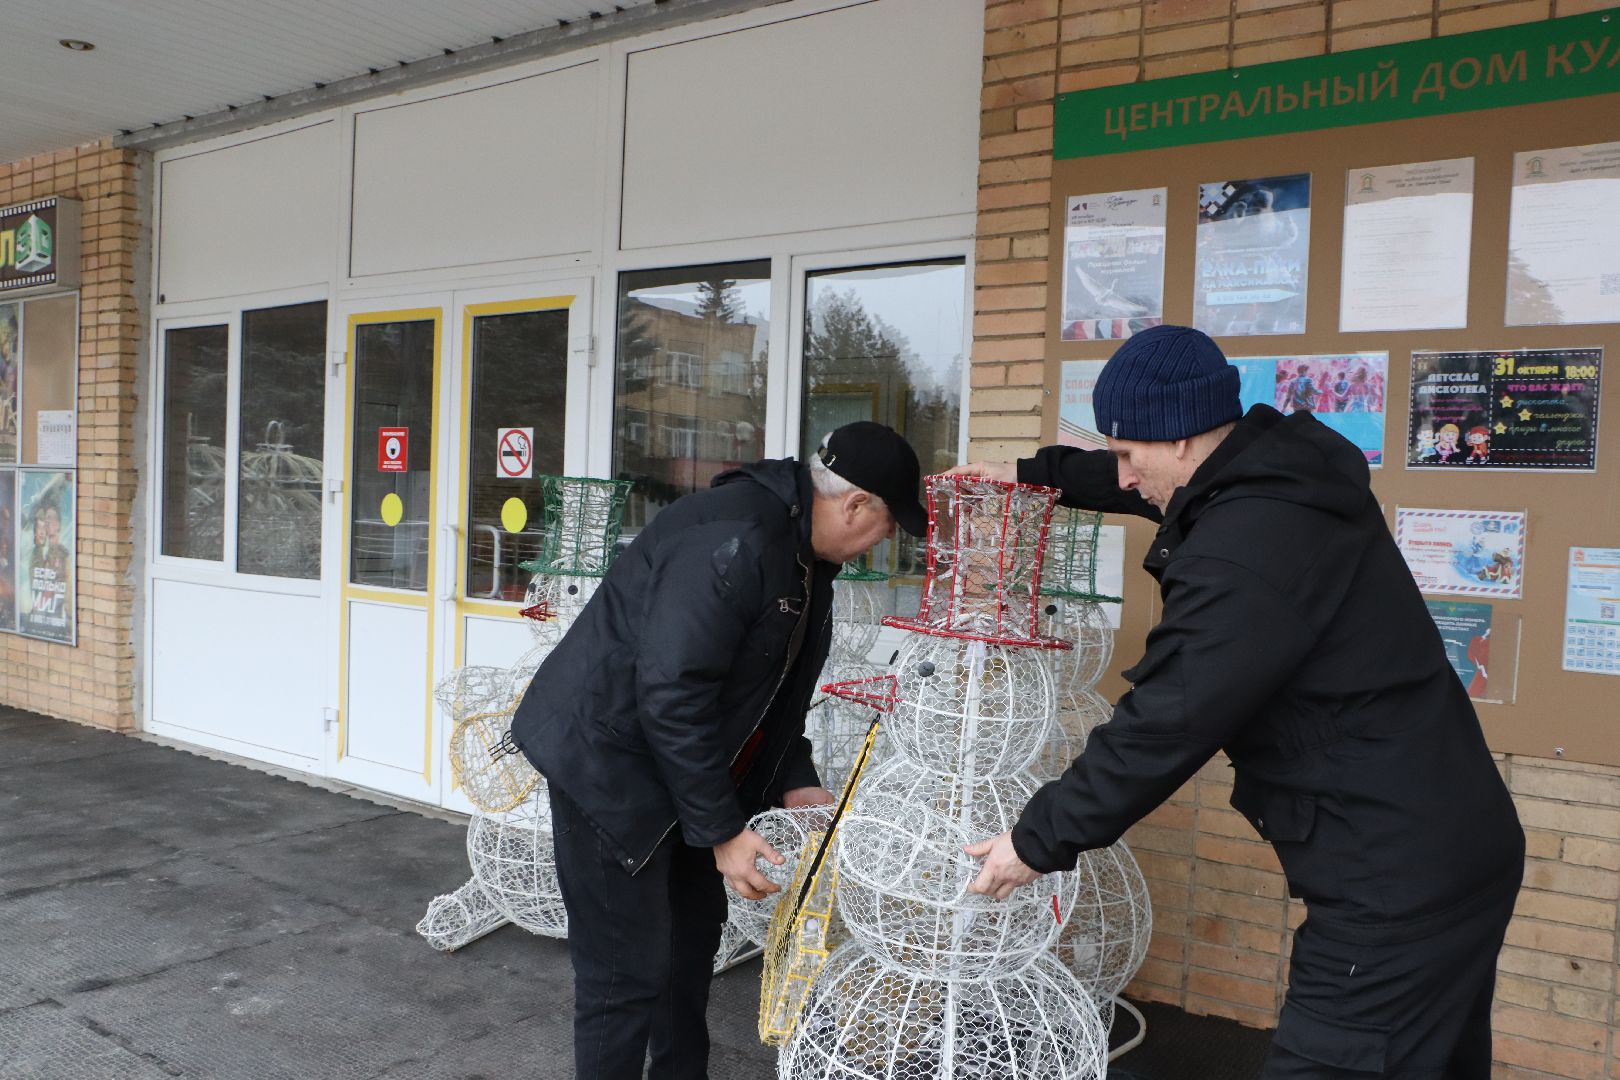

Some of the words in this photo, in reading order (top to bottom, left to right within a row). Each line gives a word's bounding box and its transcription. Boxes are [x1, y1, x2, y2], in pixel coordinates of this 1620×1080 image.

[1104, 59, 1398, 140] ЦЕНТРАЛЬНЫЙ
[1412, 50, 1528, 104] ДОМ
[1494, 357, 1515, 376] 31
[1517, 365, 1559, 375] ОКТЯБРЯ
[1565, 365, 1596, 379] 18:00
[1427, 372, 1480, 382] ДЕТСКАЯ
[1418, 384, 1487, 394] ДИСКОТЕКА
[1507, 384, 1527, 392] ЧТО
[1528, 383, 1548, 392] ВАС
